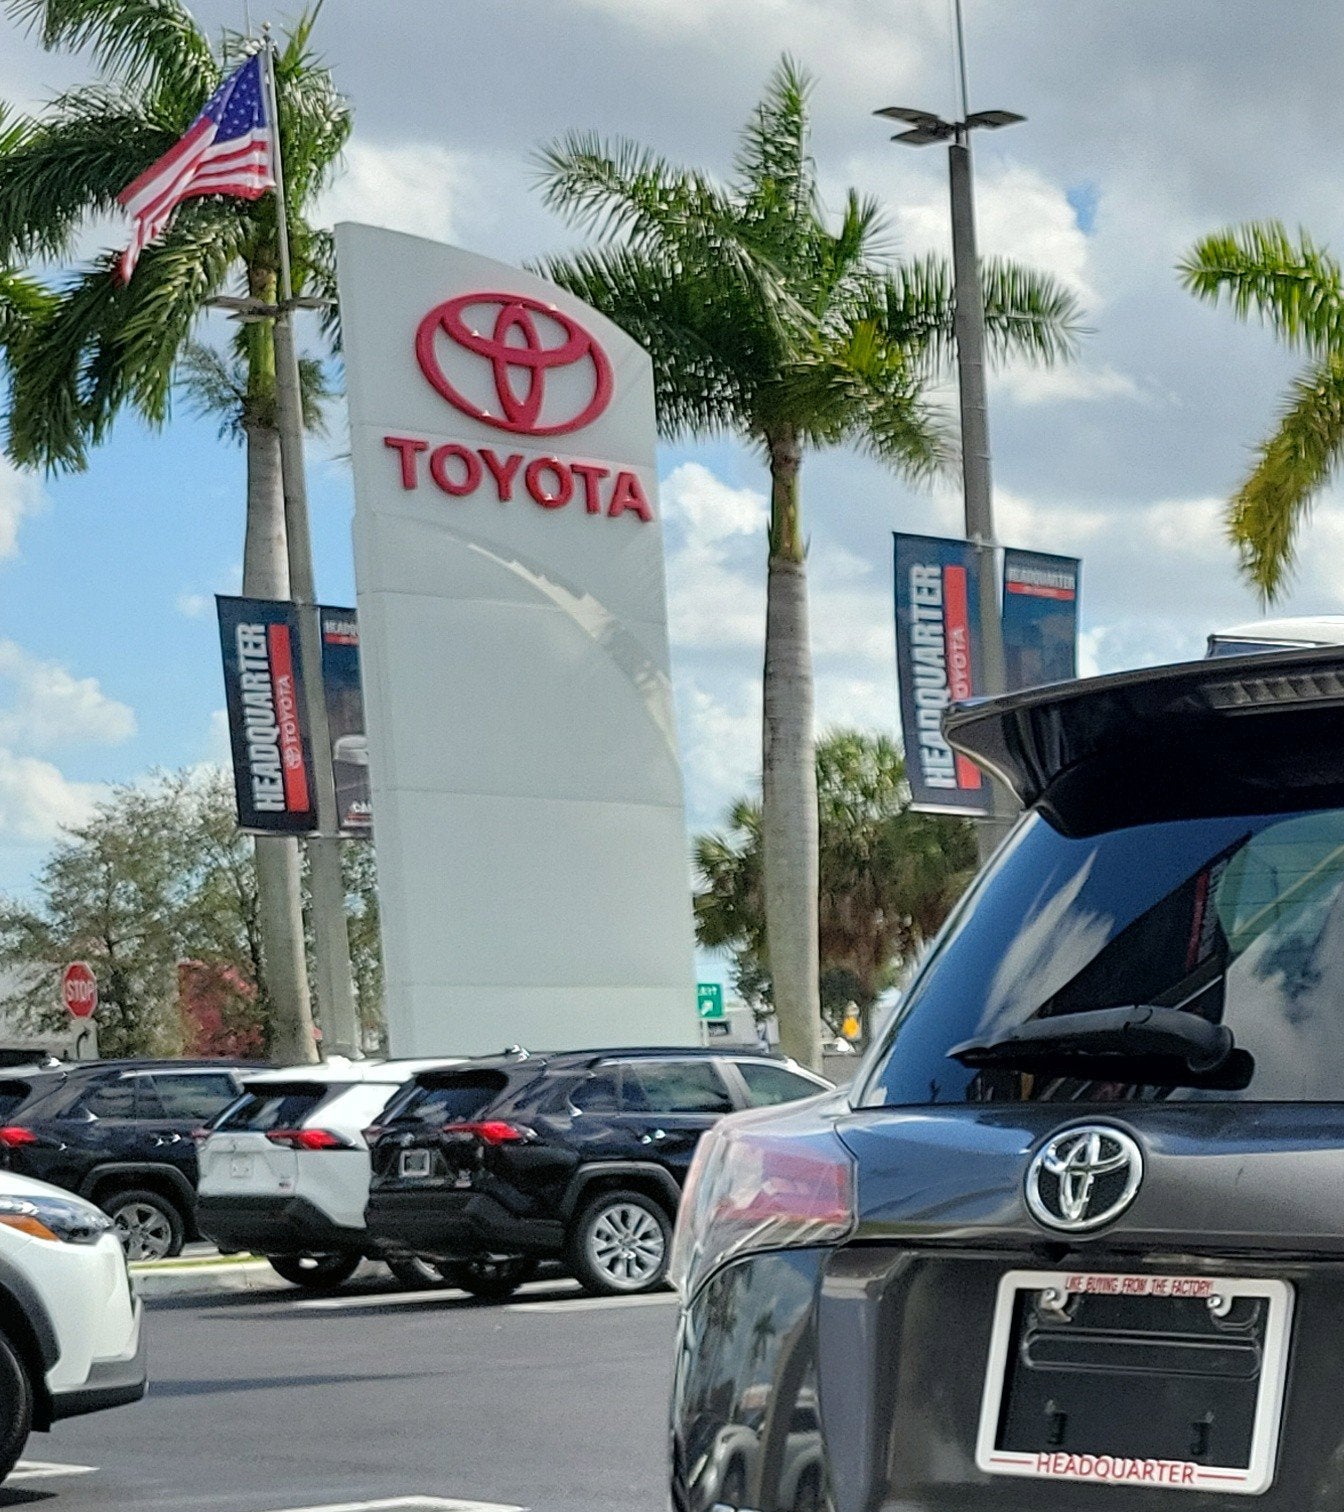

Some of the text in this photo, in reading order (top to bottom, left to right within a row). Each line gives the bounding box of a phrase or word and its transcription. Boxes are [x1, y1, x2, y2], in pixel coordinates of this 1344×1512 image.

[384, 436, 653, 522] TOYOTA
[910, 563, 958, 789] HEADQUARTER
[952, 628, 969, 699] OYOTA
[236, 622, 286, 812] HEADQUARTER
[277, 676, 298, 745] TOYOTA
[66, 980, 95, 1001] STOP
[1065, 1276, 1213, 1296] LIKE BUYING FROM THE FACTORY
[1036, 1453, 1195, 1484] HEADQUARTER
